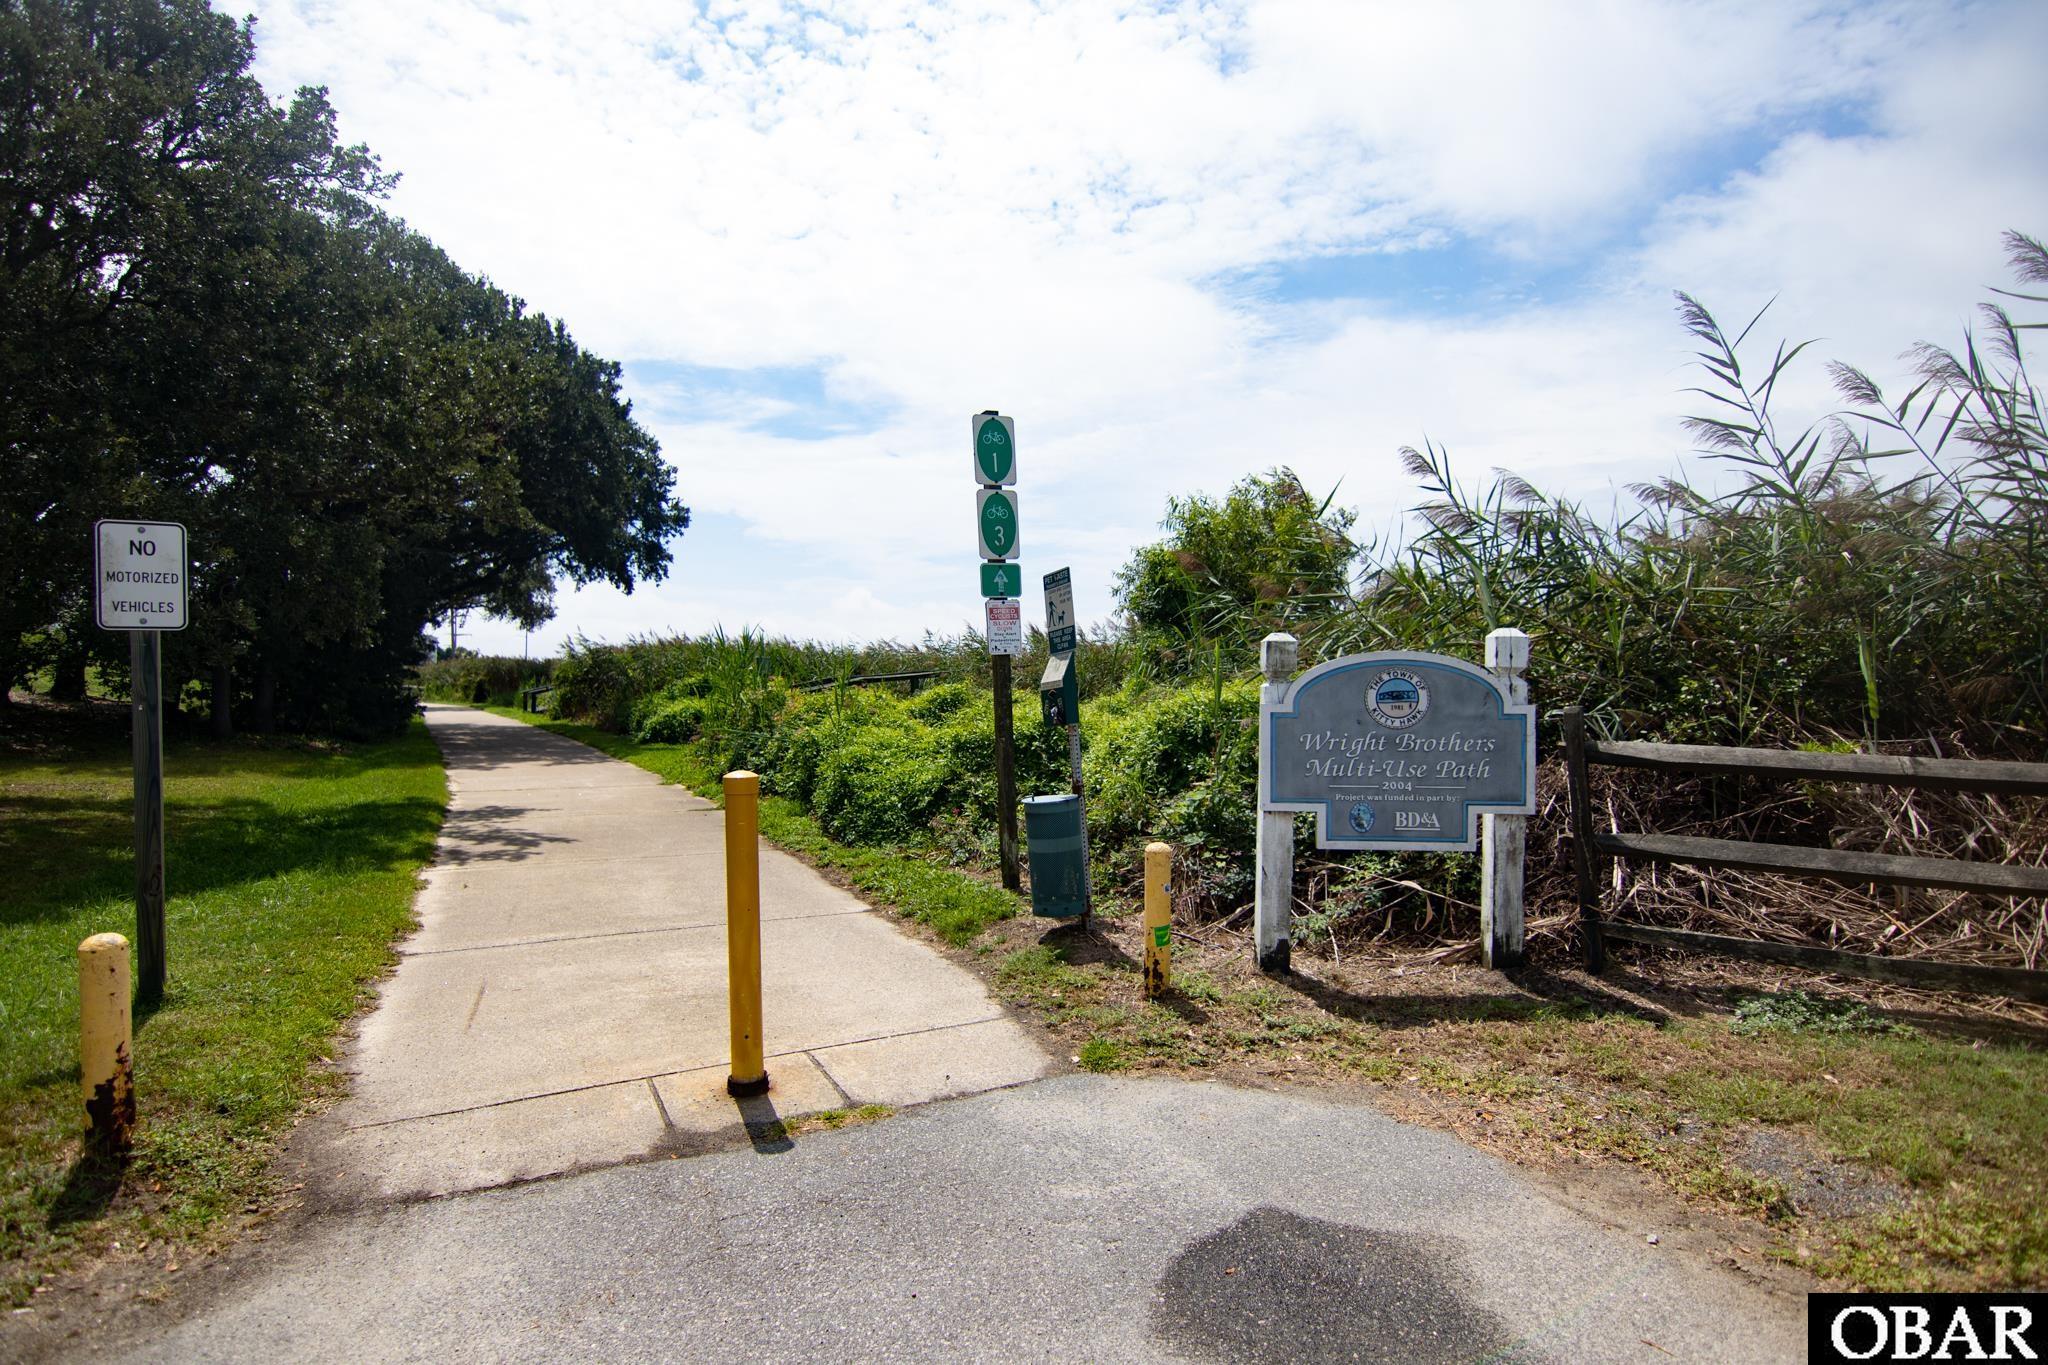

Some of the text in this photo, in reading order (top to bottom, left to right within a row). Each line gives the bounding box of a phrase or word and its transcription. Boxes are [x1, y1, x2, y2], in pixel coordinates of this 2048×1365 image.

[993, 453, 998, 472] 1
[994, 525, 1005, 546] 3
[129, 540, 156, 556] NO
[106, 571, 179, 584] MOTORIZED
[112, 601, 174, 613] VEHICLES
[1370, 671, 1426, 690] THE TOWN OF
[1370, 708, 1423, 726] KITTY HAWK
[1300, 731, 1496, 757] Wright Brothers
[1305, 758, 1491, 779] Multi-Use Path
[1382, 781, 1412, 791] 2004
[1335, 793, 1364, 801] Project
[1426, 794, 1445, 802] part
[1395, 811, 1441, 828] BD&A
